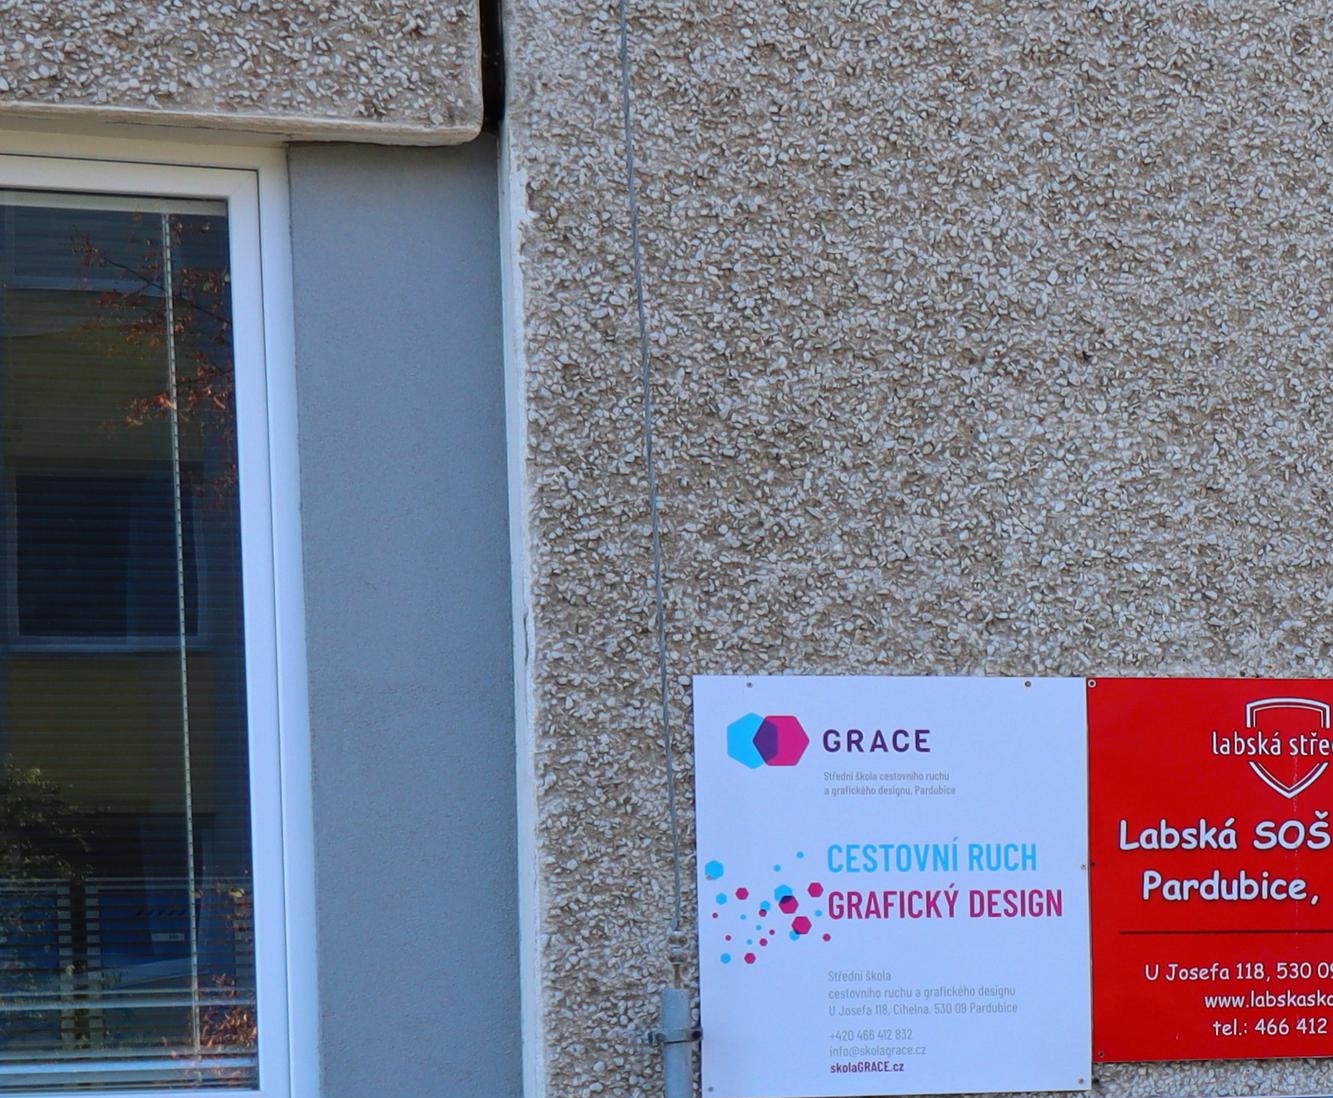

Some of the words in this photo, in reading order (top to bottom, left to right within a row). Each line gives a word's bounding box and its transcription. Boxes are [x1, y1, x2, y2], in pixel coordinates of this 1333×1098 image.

[822, 728, 931, 753] GRACE
[1212, 730, 1281, 756] labská
[823, 771, 854, 781] Střední
[855, 771, 878, 781] škola
[879, 771, 924, 781] cestovního
[925, 771, 950, 781] ruchu
[824, 787, 830, 795] a
[831, 786, 876, 797] grafického
[914, 785, 956, 795] Pardubice
[1119, 816, 1238, 851] Labská
[1253, 809, 1331, 851] SOŠ
[827, 836, 959, 873] CESTOVNÍ
[968, 842, 1037, 872] RUCH
[1142, 869, 1319, 906] Pardubice,
[827, 882, 959, 920] GRAFICKÝ
[969, 888, 1063, 918] DESIGN
[828, 970, 864, 982] Střední
[865, 970, 892, 982] škola
[1144, 963, 1159, 981] U
[1165, 962, 1230, 982] Josefa
[1236, 962, 1271, 982] 118,
[1276, 962, 1312, 980] 530
[828, 987, 882, 1000] cestovního
[883, 986, 913, 999] ruchu
[915, 989, 921, 998] a
[923, 985, 976, 1000] grafického
[978, 984, 1016, 999] designu
[829, 1005, 836, 1017] U
[838, 1004, 872, 1016] Josefa
[934, 1002, 952, 1015] 530
[954, 1002, 967, 1014] 09
[970, 1002, 1018, 1014] Pardubice
[1212, 1019, 1248, 1036] tel.:
[1254, 1018, 1290, 1036] 466
[1296, 1017, 1328, 1035] 412
[829, 1030, 854, 1042] +420
[857, 1030, 875, 1041] 466
[877, 1029, 892, 1041] 412
[895, 1029, 913, 1040] 832
[829, 1045, 927, 1059] info@skolagrace.cz
[830, 1060, 905, 1074] skolaGRACE.cz
